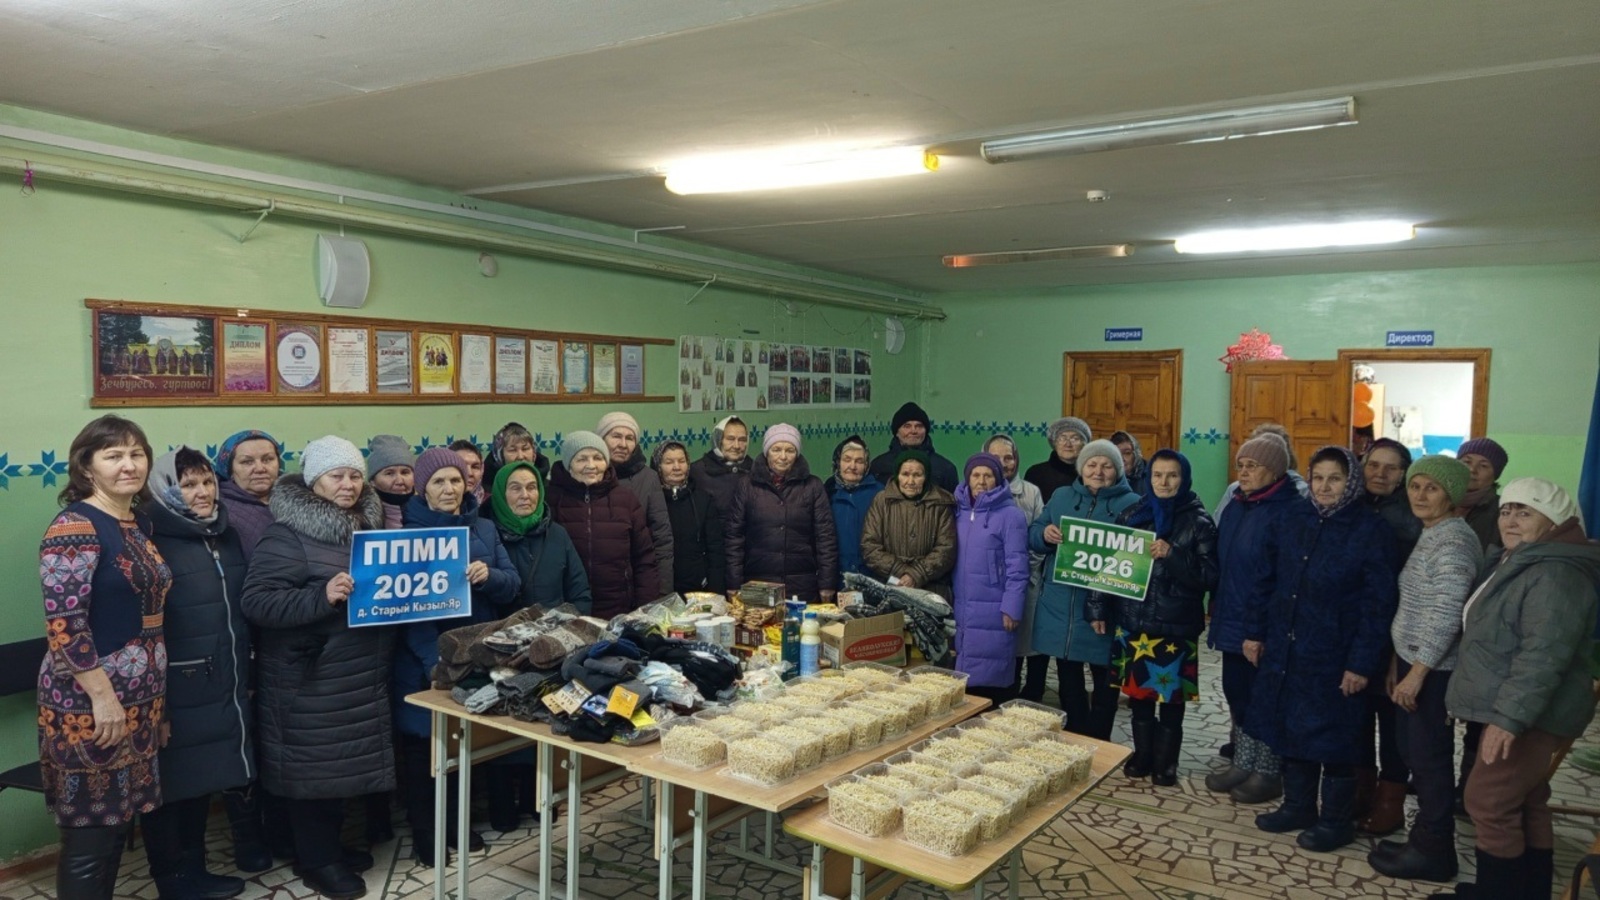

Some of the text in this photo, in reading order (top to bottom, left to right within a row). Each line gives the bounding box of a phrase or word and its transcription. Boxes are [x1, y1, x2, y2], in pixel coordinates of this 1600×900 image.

[229, 340, 261, 350] ДИПЛОМ
[1388, 333, 1433, 345] Директор
[363, 536, 459, 566] ППМИ
[1068, 524, 1145, 555] ППМИ
[1072, 550, 1133, 578] 2026
[373, 570, 449, 600] 2026
[1071, 570, 1100, 584] Старый
[1101, 575, 1141, 594] Кызыл-Яр
[357, 598, 461, 618] д. Старый Кызыл-Яр
